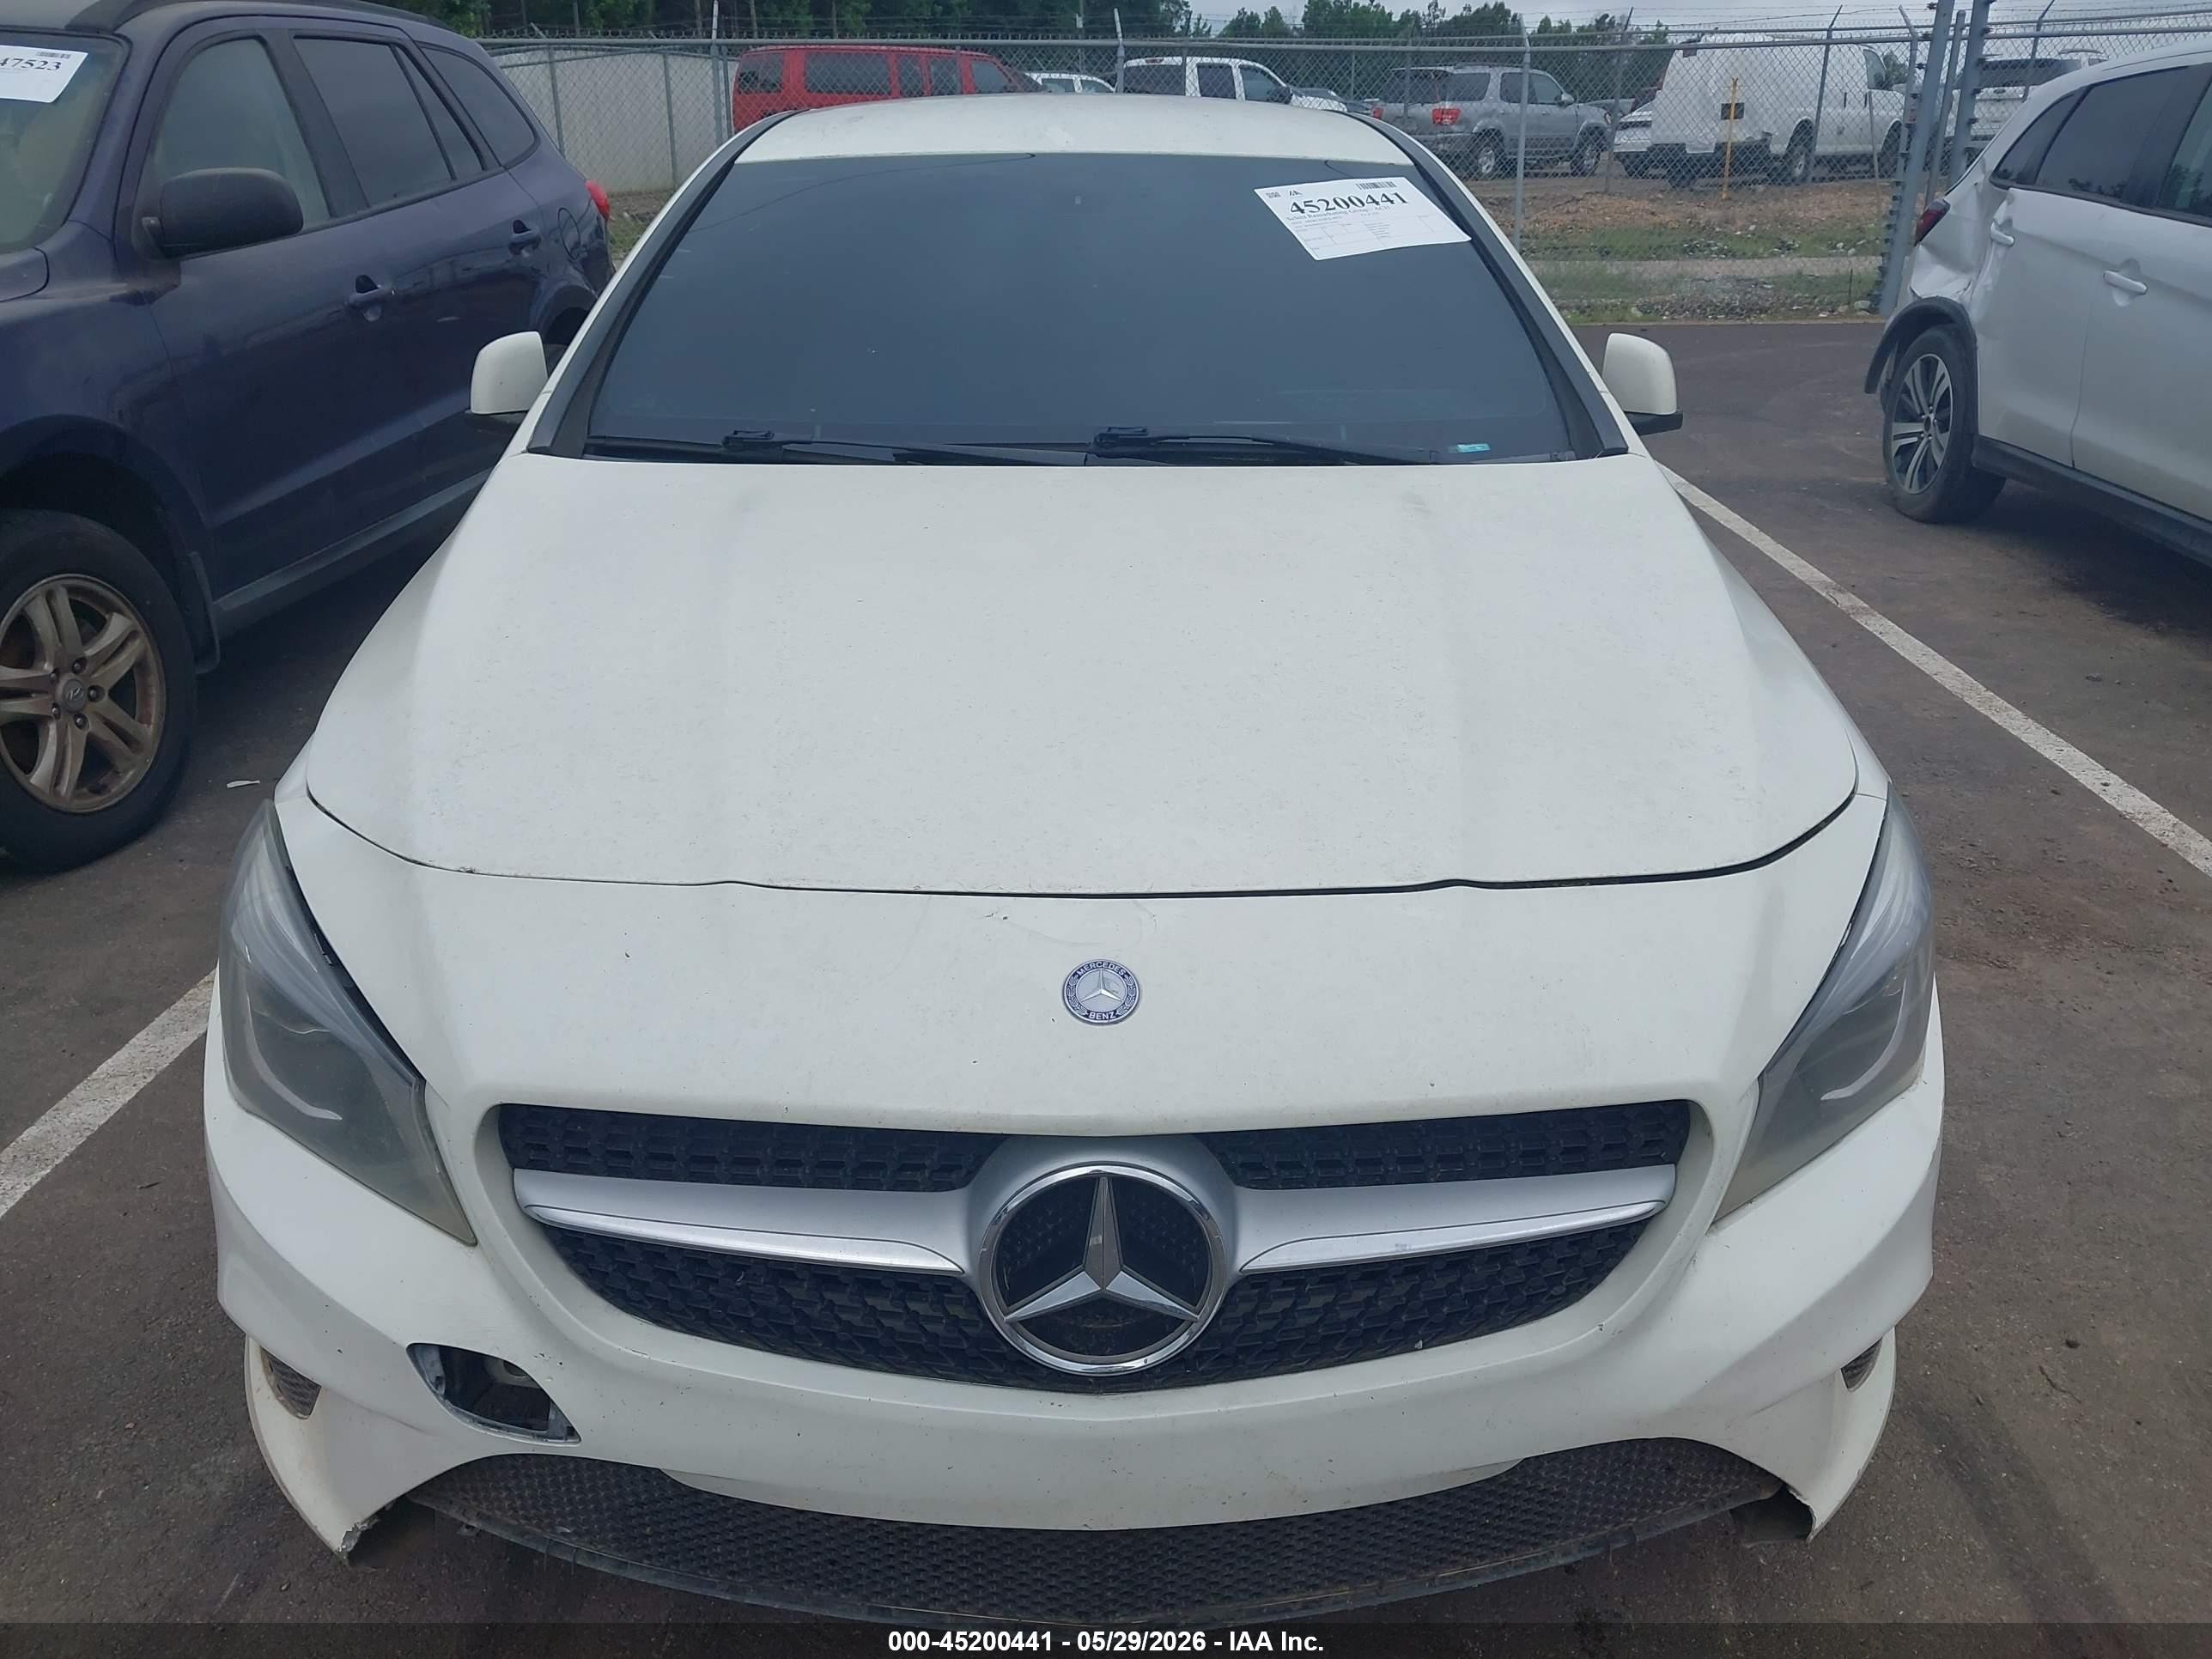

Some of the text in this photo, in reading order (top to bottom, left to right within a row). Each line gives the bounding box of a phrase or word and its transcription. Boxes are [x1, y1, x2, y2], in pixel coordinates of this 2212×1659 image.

[1290, 191, 1408, 215] 45200441
[1077, 962, 1127, 976] MERCEDES
[1088, 1012, 1116, 1020] BENZ
